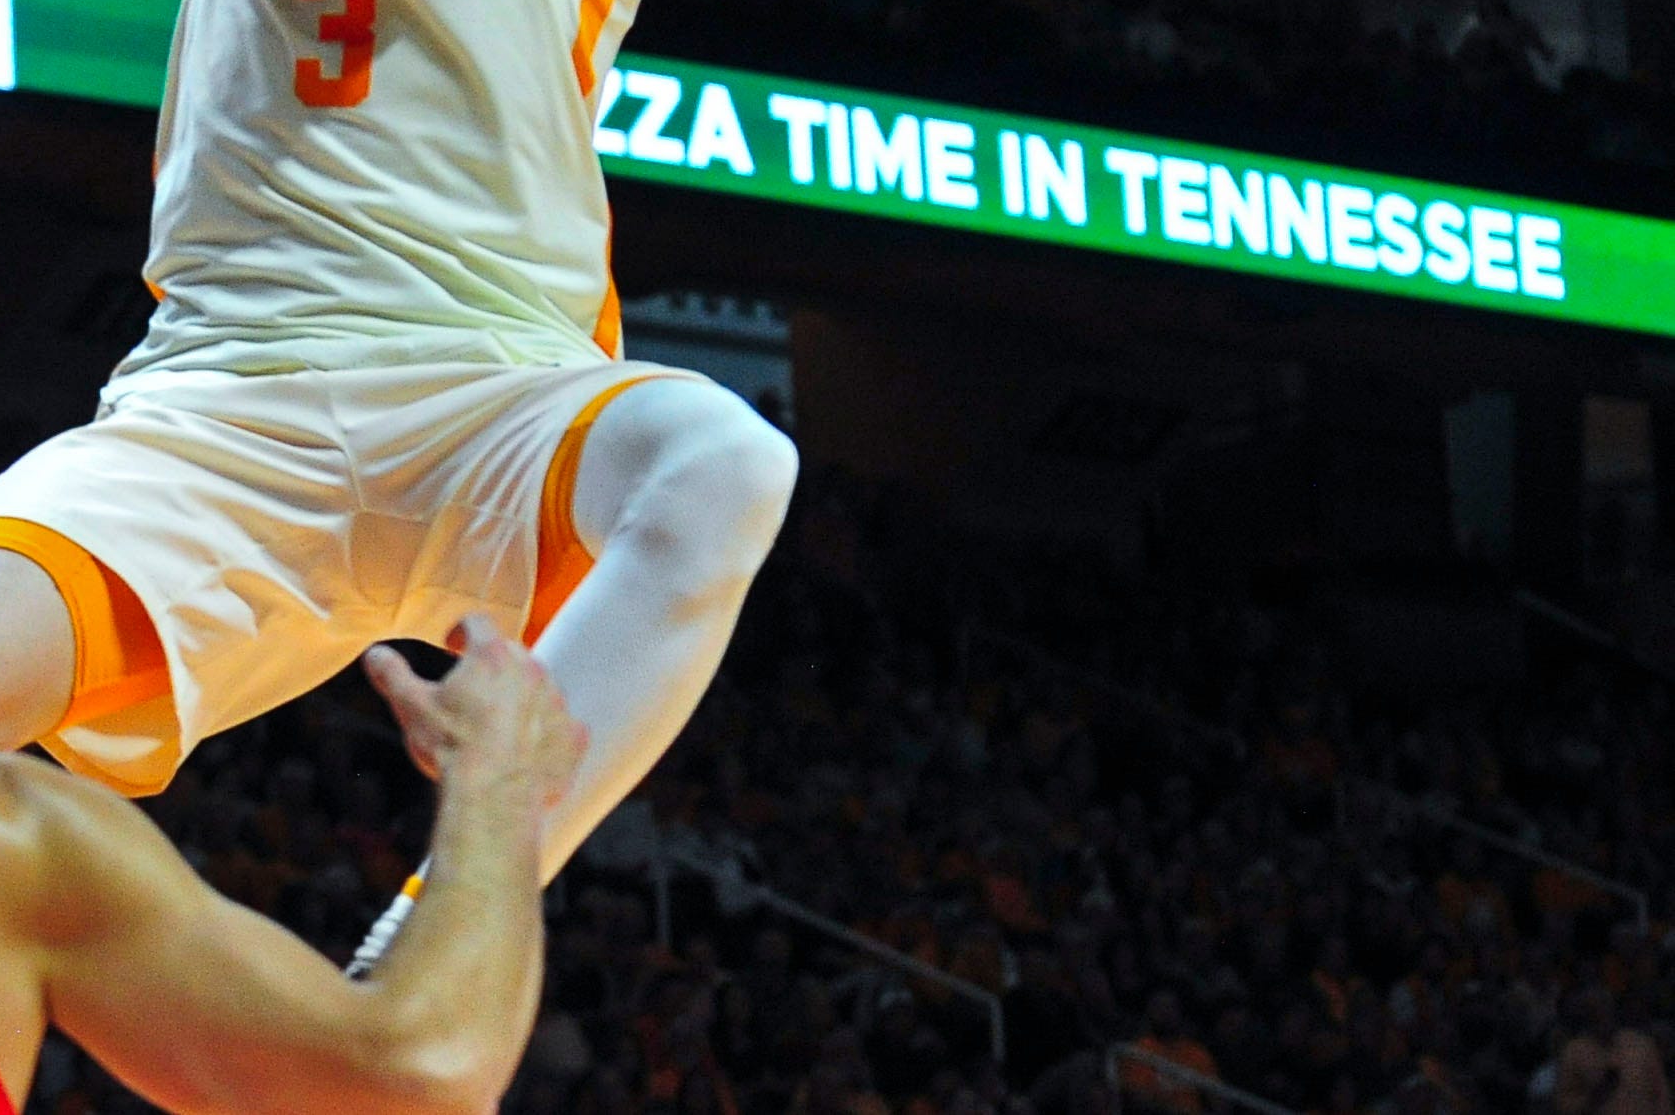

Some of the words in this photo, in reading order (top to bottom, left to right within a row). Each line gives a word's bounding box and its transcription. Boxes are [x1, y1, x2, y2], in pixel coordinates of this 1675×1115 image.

[768, 92, 980, 210] TIME
[998, 128, 1089, 228] IN
[1103, 145, 1566, 301] TENNESSEE
